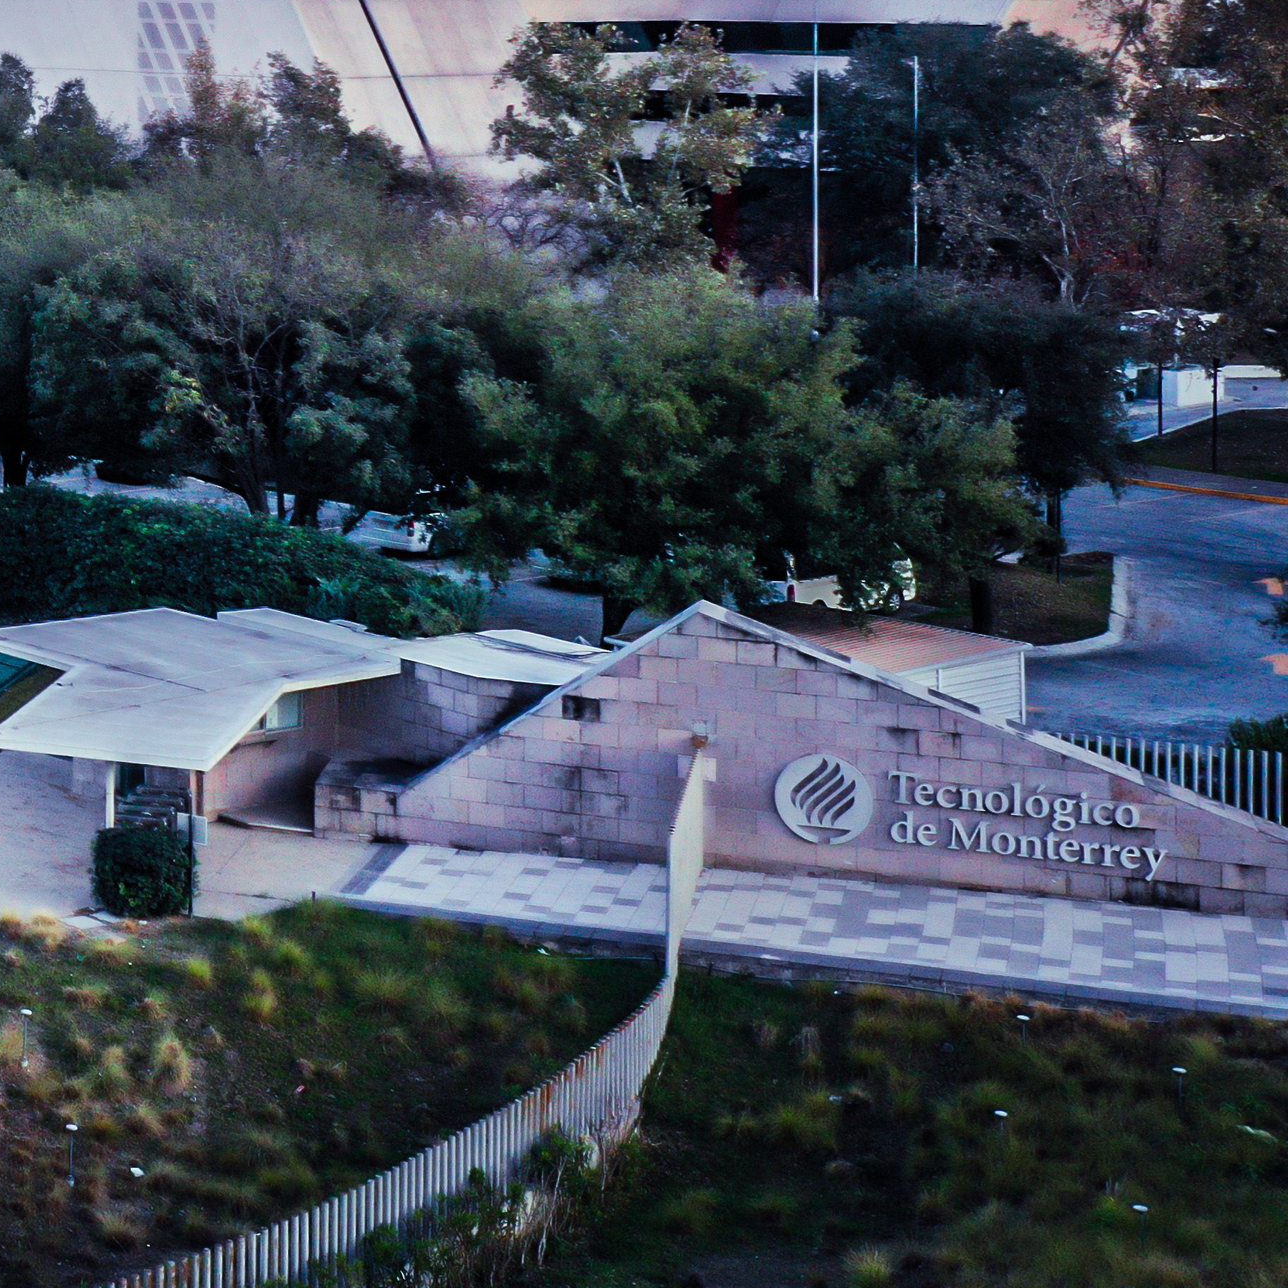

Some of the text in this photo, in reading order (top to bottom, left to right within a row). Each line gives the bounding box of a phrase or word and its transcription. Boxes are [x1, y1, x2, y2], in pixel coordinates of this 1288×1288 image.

[888, 770, 1140, 832] Tecnológico
[890, 811, 1168, 882] de Monterrey
